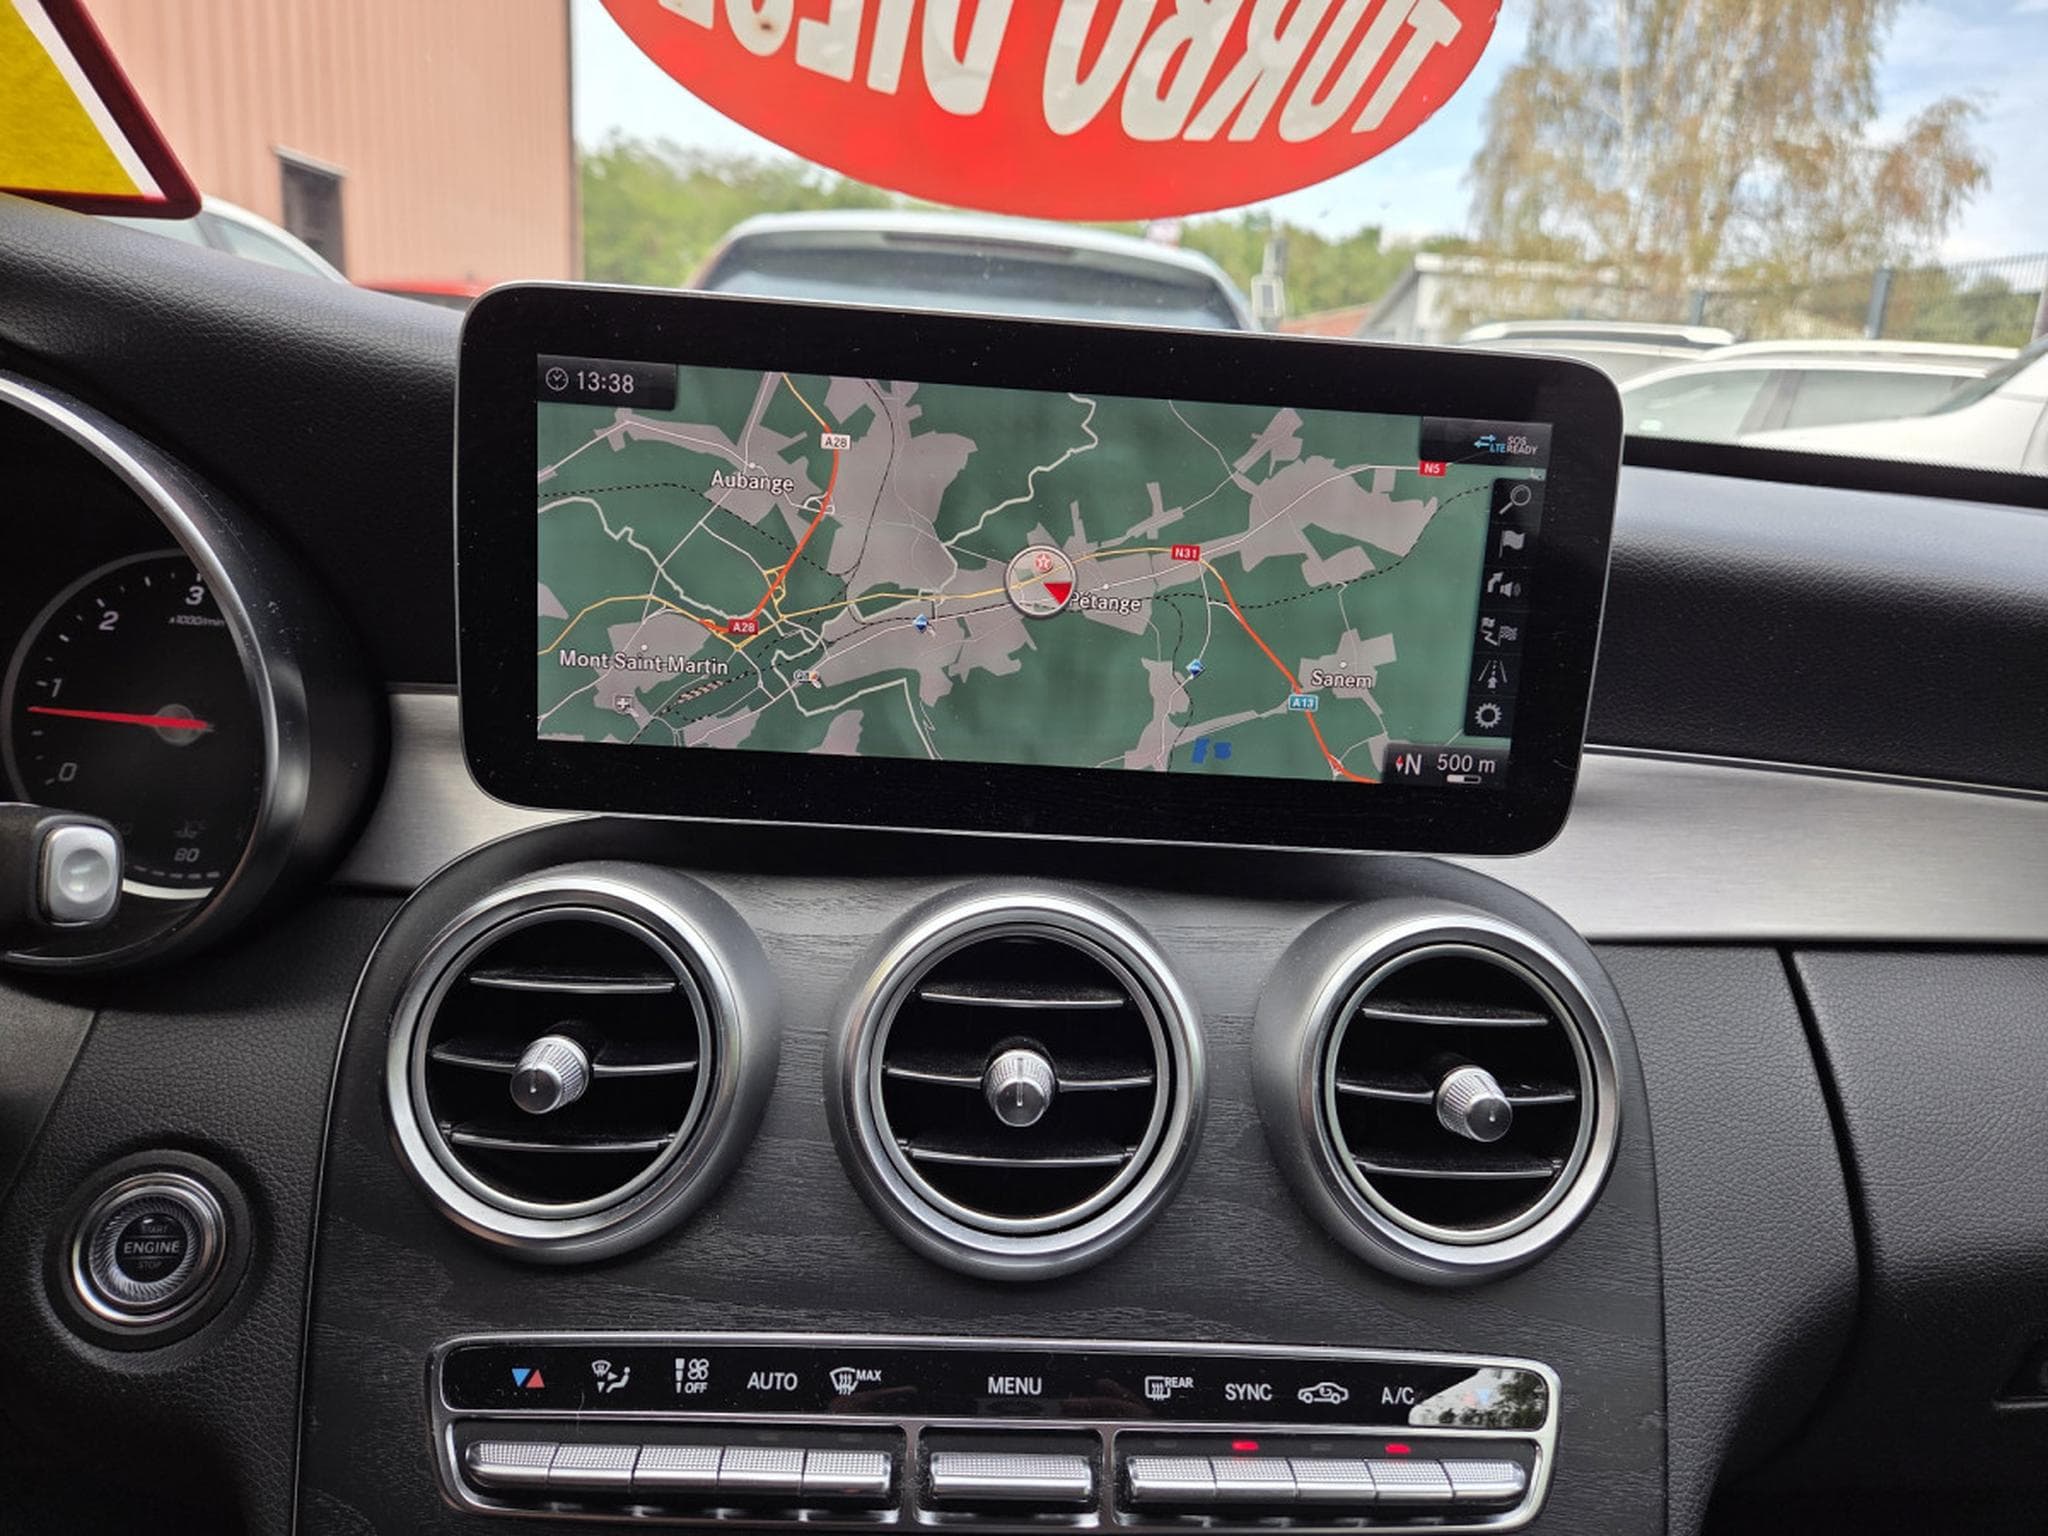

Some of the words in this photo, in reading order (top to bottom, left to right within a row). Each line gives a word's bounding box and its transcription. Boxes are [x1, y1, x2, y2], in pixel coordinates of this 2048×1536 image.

[576, 371, 635, 395] 13:38
[825, 435, 848, 448] A28
[1507, 436, 1527, 446] SOS
[1506, 445, 1537, 456] READY
[1424, 463, 1441, 474] N5
[711, 470, 795, 495] Aubange
[1175, 547, 1198, 559] N31
[186, 586, 204, 605] 3
[1069, 591, 1140, 614] Pétange
[99, 612, 119, 631] 2
[733, 621, 756, 634] A28
[559, 651, 608, 668] Mont
[51, 678, 62, 697] 1
[1312, 671, 1372, 689] Sanem
[1293, 696, 1315, 709] A13
[58, 763, 77, 782] 0
[1405, 754, 1421, 775] N
[1437, 754, 1473, 772] 500
[1478, 759, 1496, 773] m
[174, 848, 199, 862] 80
[124, 1241, 180, 1254] ENGINE
[747, 1371, 798, 1391] AUTO
[856, 1369, 882, 1382] MAX
[1164, 1376, 1194, 1389] REAR
[685, 1382, 707, 1393] OFF
[987, 1376, 1042, 1395] MENU
[1225, 1383, 1273, 1401] SYNC
[1381, 1386, 1415, 1405] A/C
